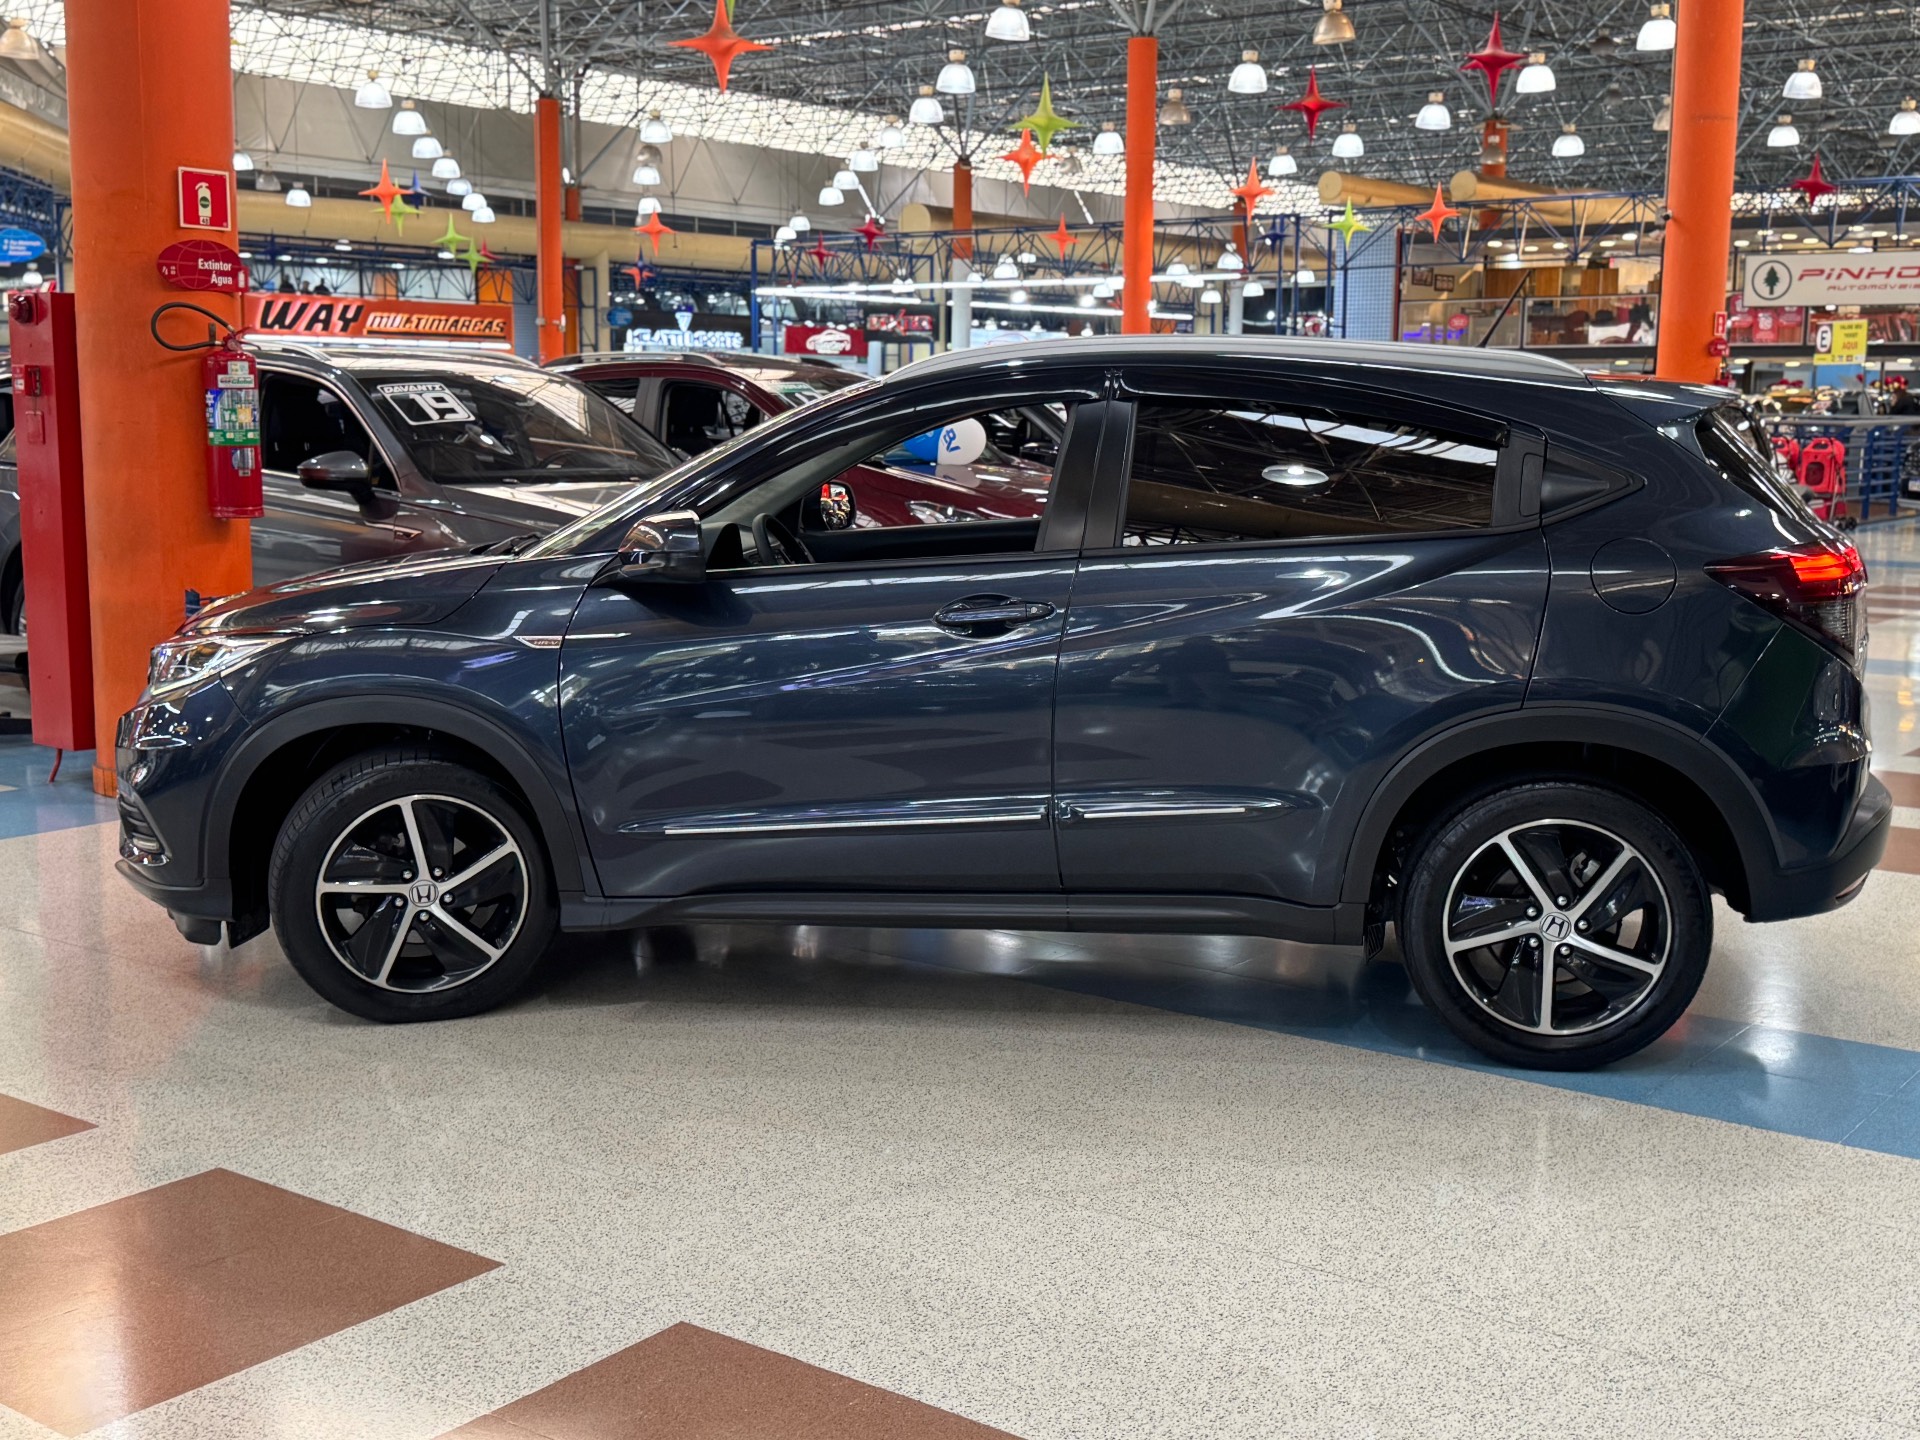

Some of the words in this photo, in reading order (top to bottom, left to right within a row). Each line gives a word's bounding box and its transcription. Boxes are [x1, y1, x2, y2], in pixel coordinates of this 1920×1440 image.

[198, 258, 232, 271] Extintor
[211, 271, 232, 286] Água
[258, 299, 364, 332] WAY
[1820, 331, 1828, 348] E
[383, 384, 443, 394] DAVANTZ
[409, 392, 470, 420] 19
